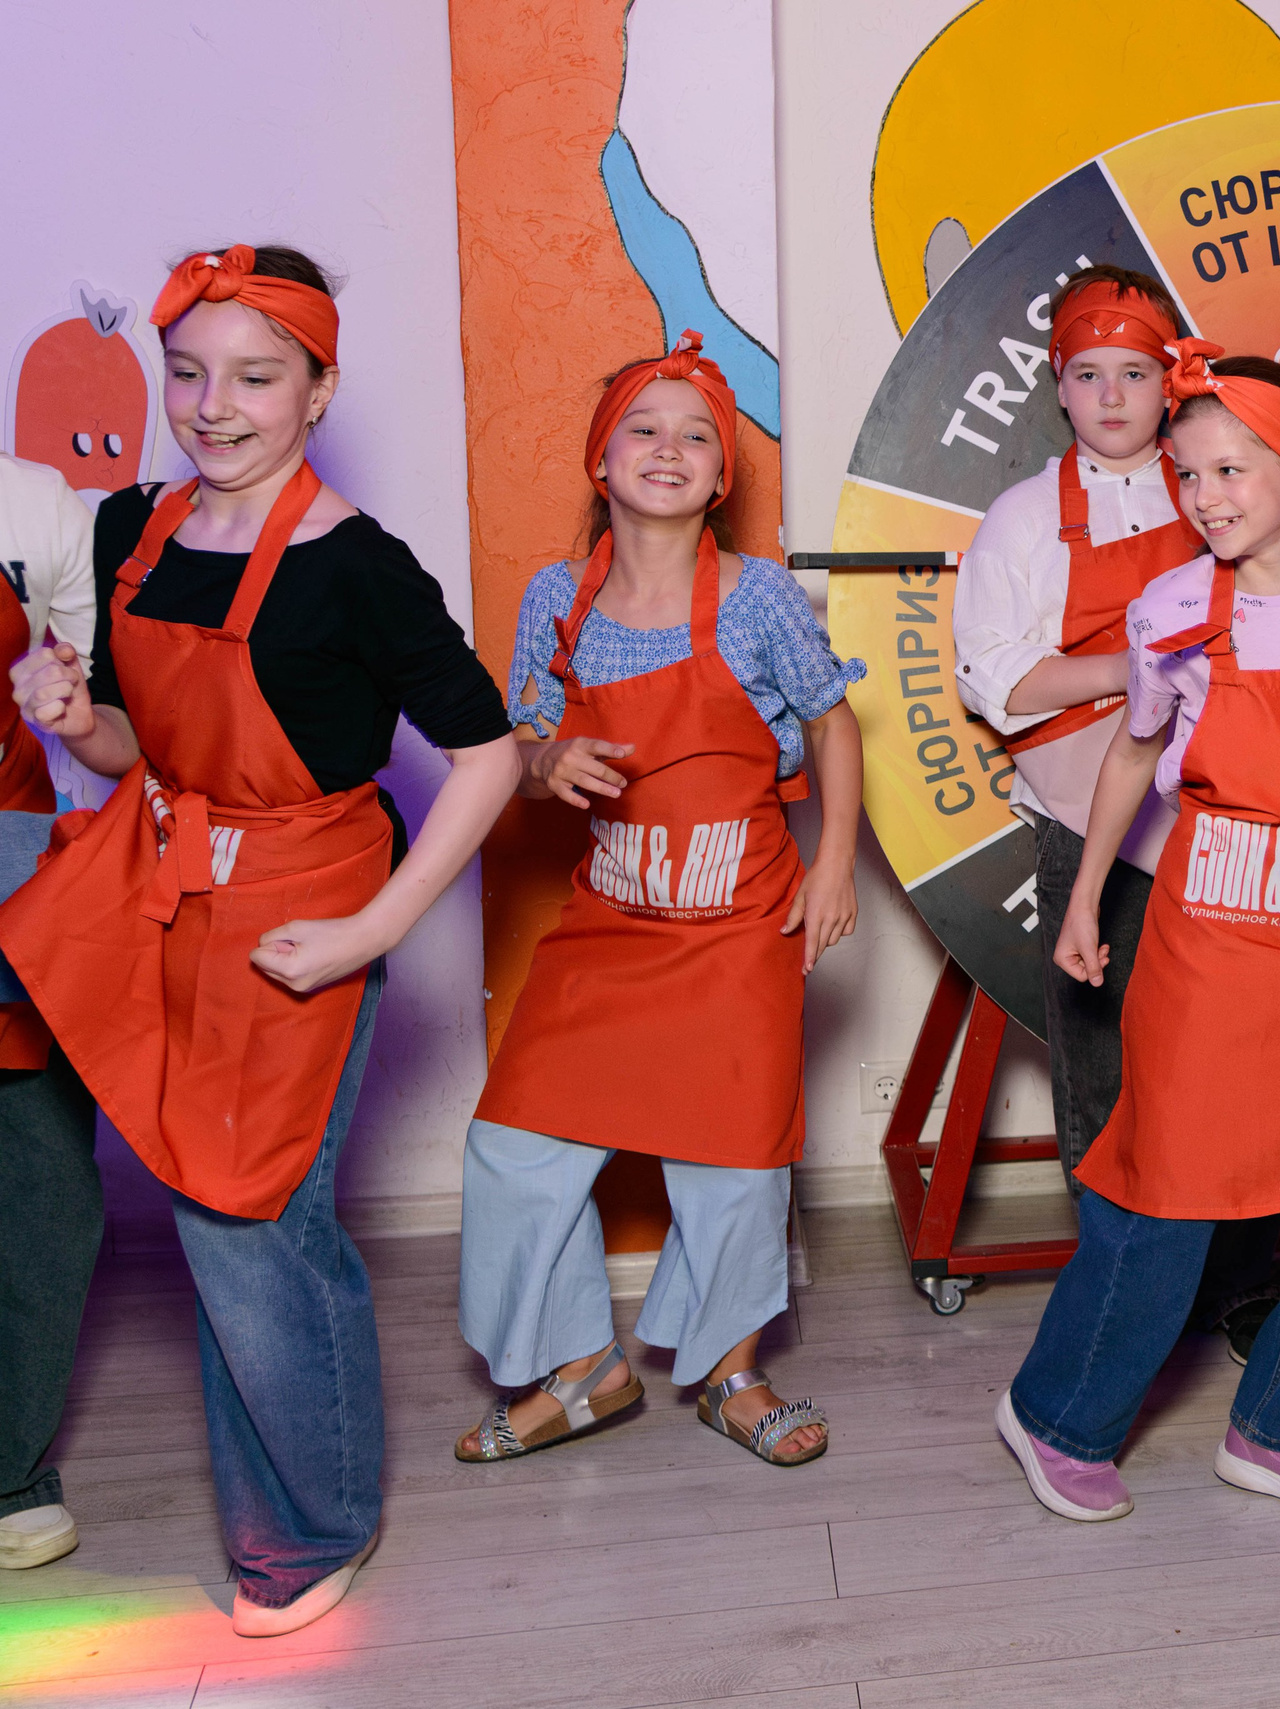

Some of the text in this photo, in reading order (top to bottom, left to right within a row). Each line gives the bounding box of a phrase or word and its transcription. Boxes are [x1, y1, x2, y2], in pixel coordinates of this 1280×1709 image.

[1192, 230, 1249, 283] ОТ
[940, 254, 1094, 455] TRA
[896, 564, 976, 816] СЮРПРИЗ
[645, 825, 674, 909] &
[676, 817, 750, 909] RUN
[1184, 812, 1271, 911] COOK
[660, 907, 733, 919] квест-шоу
[1182, 903, 1267, 924] кулинарное
